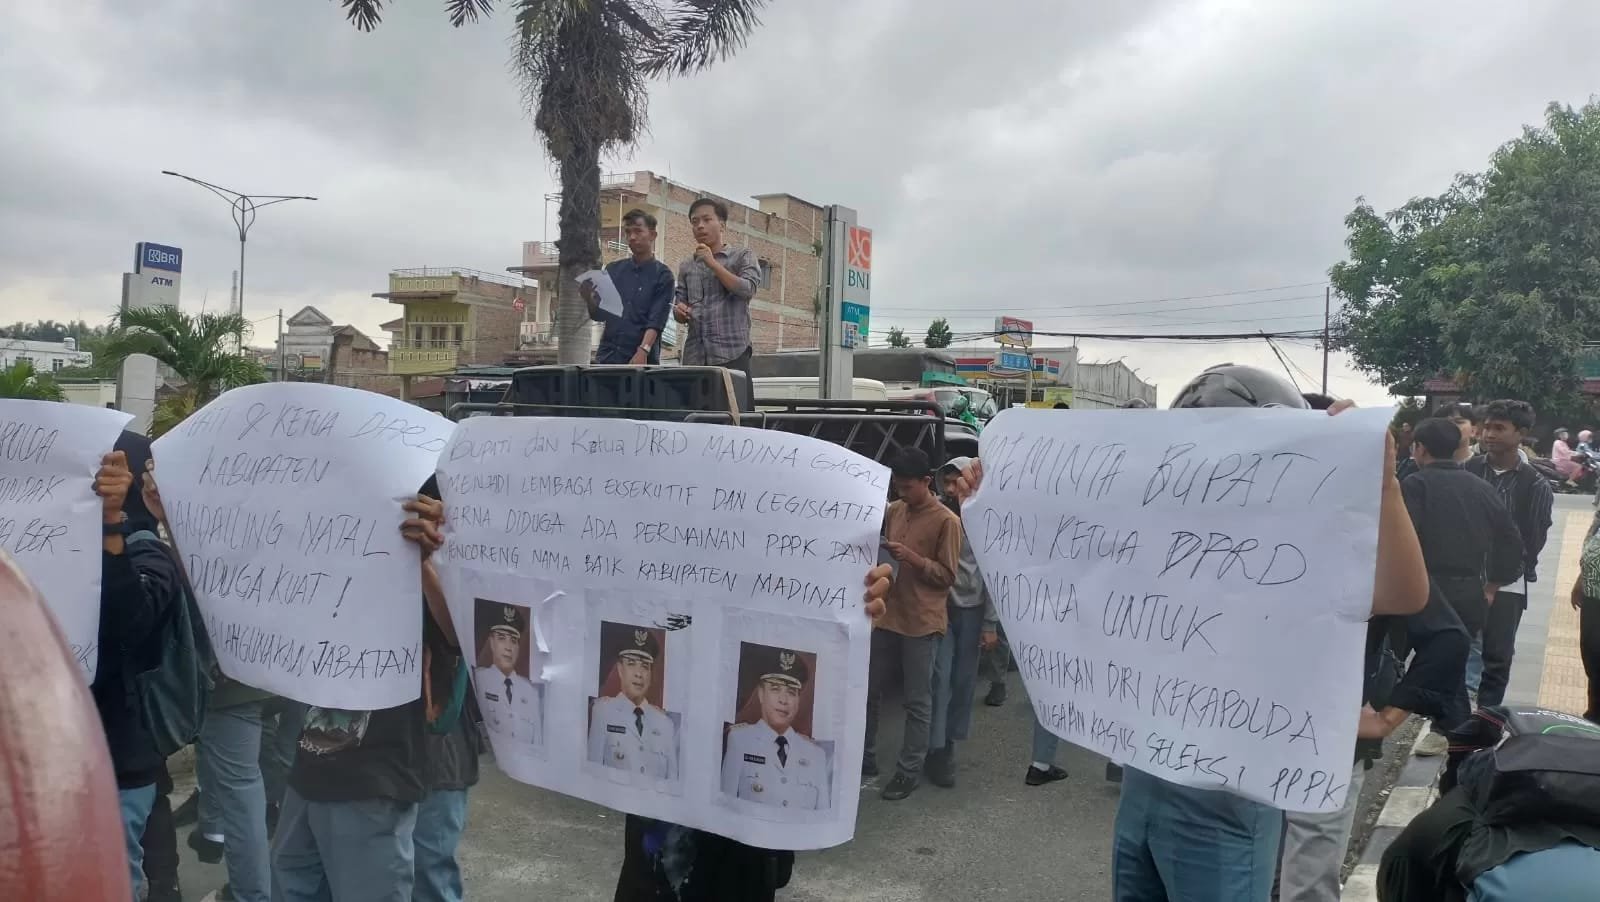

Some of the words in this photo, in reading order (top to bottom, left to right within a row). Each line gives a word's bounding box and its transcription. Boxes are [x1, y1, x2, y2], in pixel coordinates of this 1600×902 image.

[161, 252, 178, 264] BRI
[848, 269, 870, 290] BNI
[152, 276, 173, 287] ATM
[848, 306, 860, 316] ATM
[271, 401, 339, 438] KETUA
[199, 444, 330, 487] KABUPATEN
[702, 435, 798, 467] MADINA
[810, 453, 885, 489] GAGAL
[522, 475, 592, 497] LEMBAGA
[604, 478, 698, 505] EKSEKUTIF
[712, 488, 747, 513] DAN
[756, 491, 881, 522] LEGISLATIF
[300, 512, 390, 556] NATAL
[505, 509, 565, 535] DIDUGA
[581, 515, 618, 540] ADA
[766, 533, 817, 557] PPPK
[827, 540, 873, 565] DAN
[984, 508, 1037, 556] DAN
[1049, 514, 1144, 565] KETUA
[1158, 531, 1307, 585] DPRD
[189, 553, 265, 607] DIDUGA
[532, 549, 570, 573] NAMA
[585, 554, 624, 577] BAIK
[638, 560, 737, 592] KABUPATEN
[1103, 590, 1223, 654] UNTUK
[312, 640, 419, 680] JABATAN
[1270, 767, 1347, 809] PPPK
